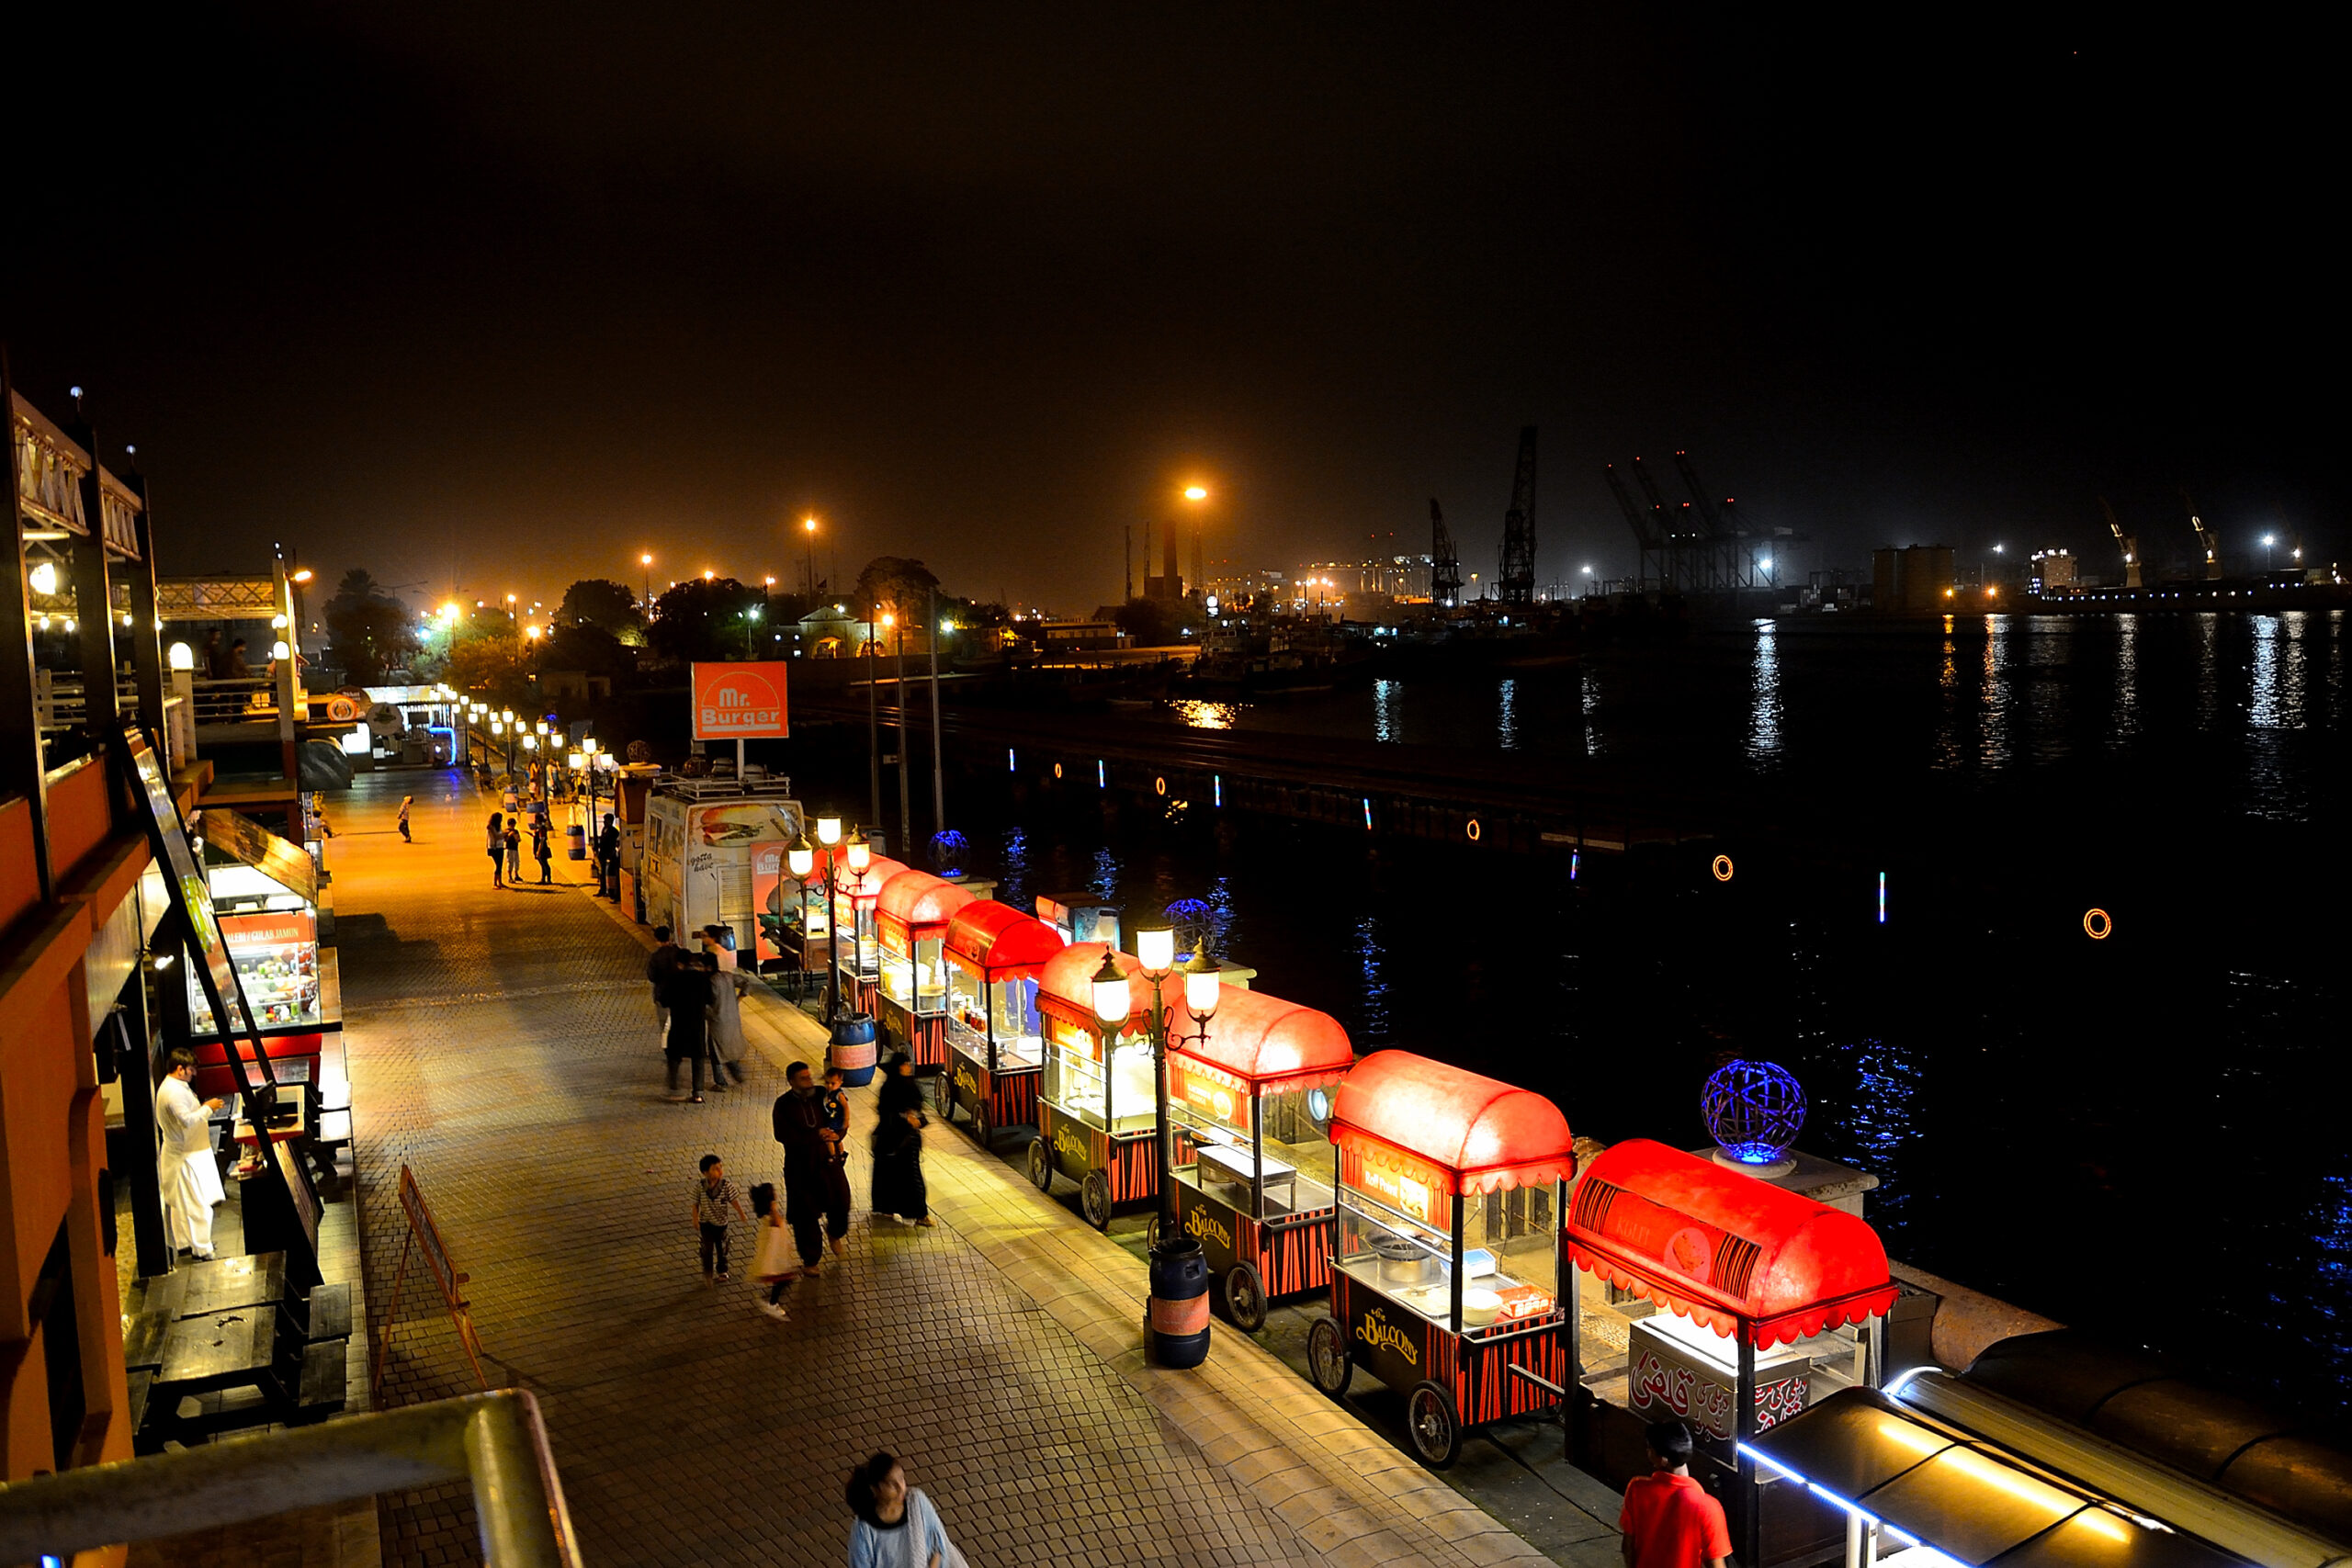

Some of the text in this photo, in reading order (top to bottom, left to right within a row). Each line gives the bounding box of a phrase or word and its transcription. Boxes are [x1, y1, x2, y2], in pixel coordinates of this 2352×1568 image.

[719, 687, 751, 707] Mr.
[701, 708, 780, 727] Burger
[690, 852, 712, 867] gotta
[251, 929, 274, 942] GULAB
[275, 926, 299, 940] JAMUN
[1364, 1170, 1398, 1199] Roll Point
